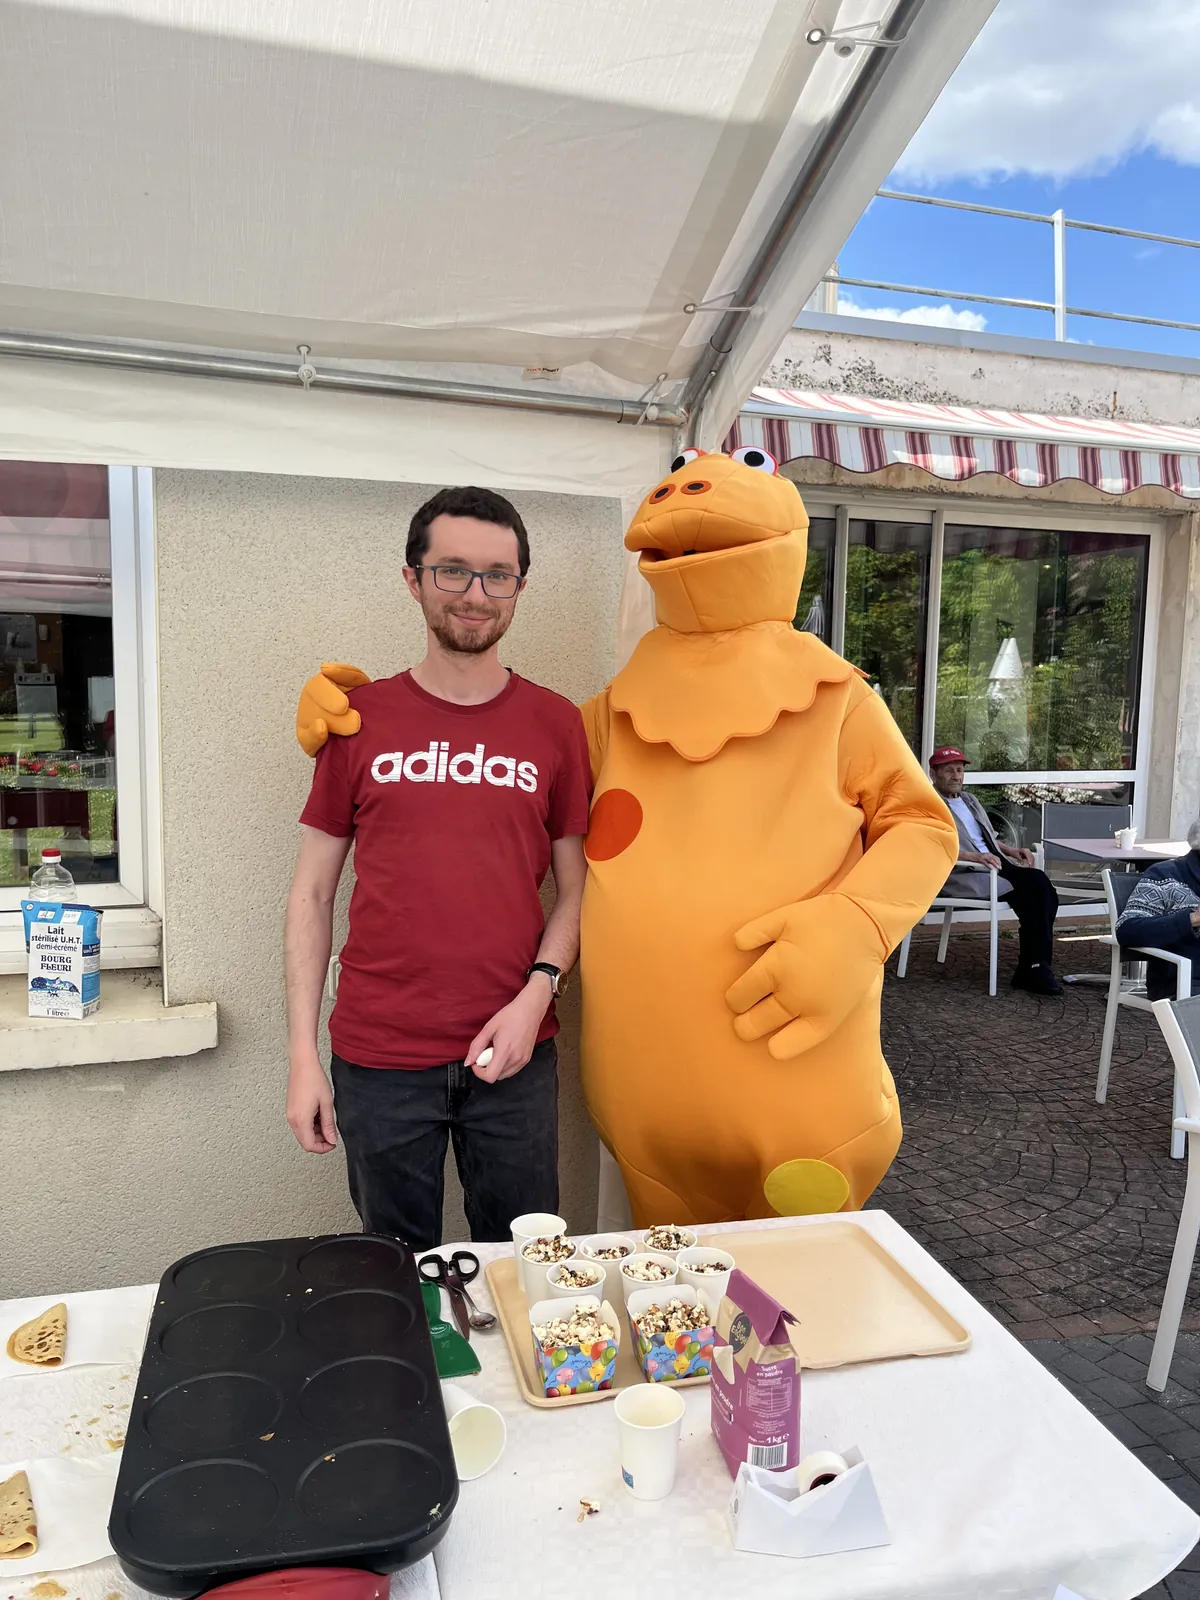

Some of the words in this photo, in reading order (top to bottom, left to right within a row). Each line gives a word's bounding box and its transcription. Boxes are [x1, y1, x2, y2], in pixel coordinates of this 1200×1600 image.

[371, 741, 539, 793] adidas
[47, 925, 65, 935] Lait
[31, 933, 59, 943] stérilisé
[60, 936, 82, 945] U.H.T.
[36, 942, 78, 952] demi-écrémé
[40, 954, 72, 964] BOURG
[40, 962, 72, 972] FLEURI
[764, 1369, 784, 1379] poudre
